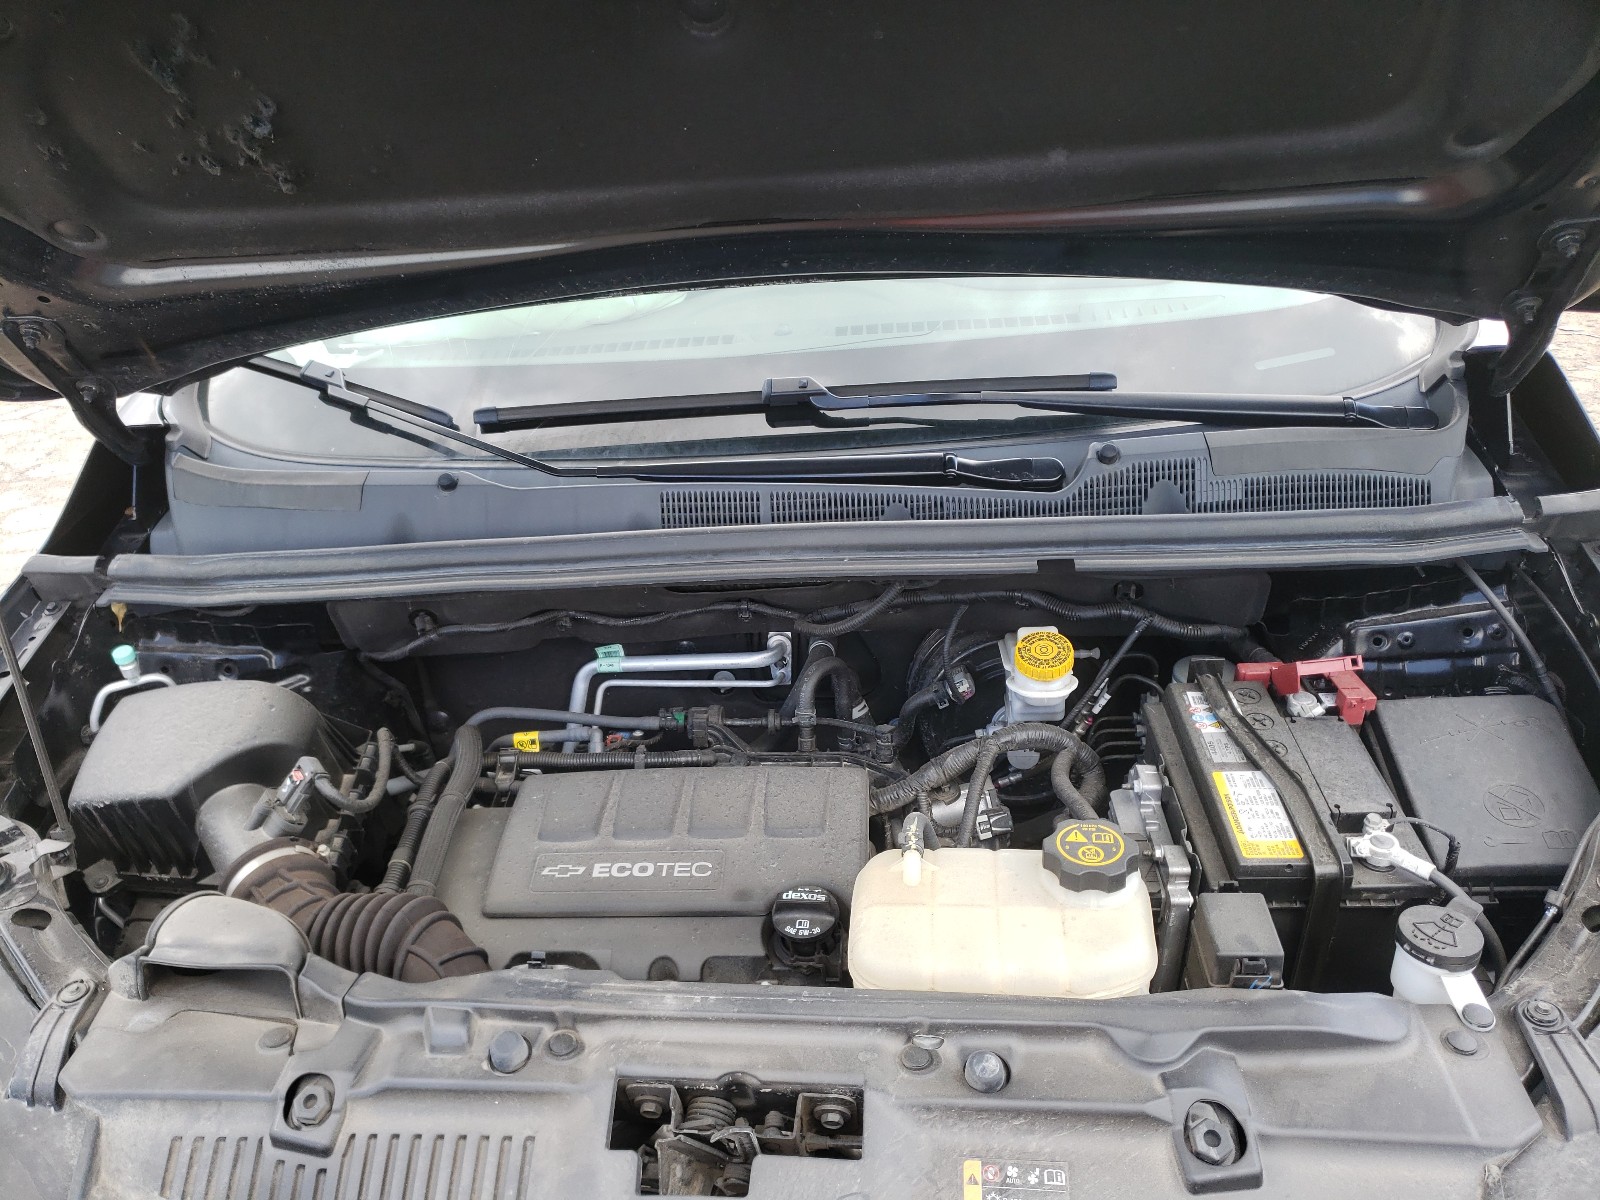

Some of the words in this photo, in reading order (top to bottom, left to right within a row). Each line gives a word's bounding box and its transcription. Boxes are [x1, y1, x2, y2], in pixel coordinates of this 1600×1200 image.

[592, 862, 712, 877] ECOTEC
[782, 890, 827, 901] dexos
[784, 925, 798, 935] SAE
